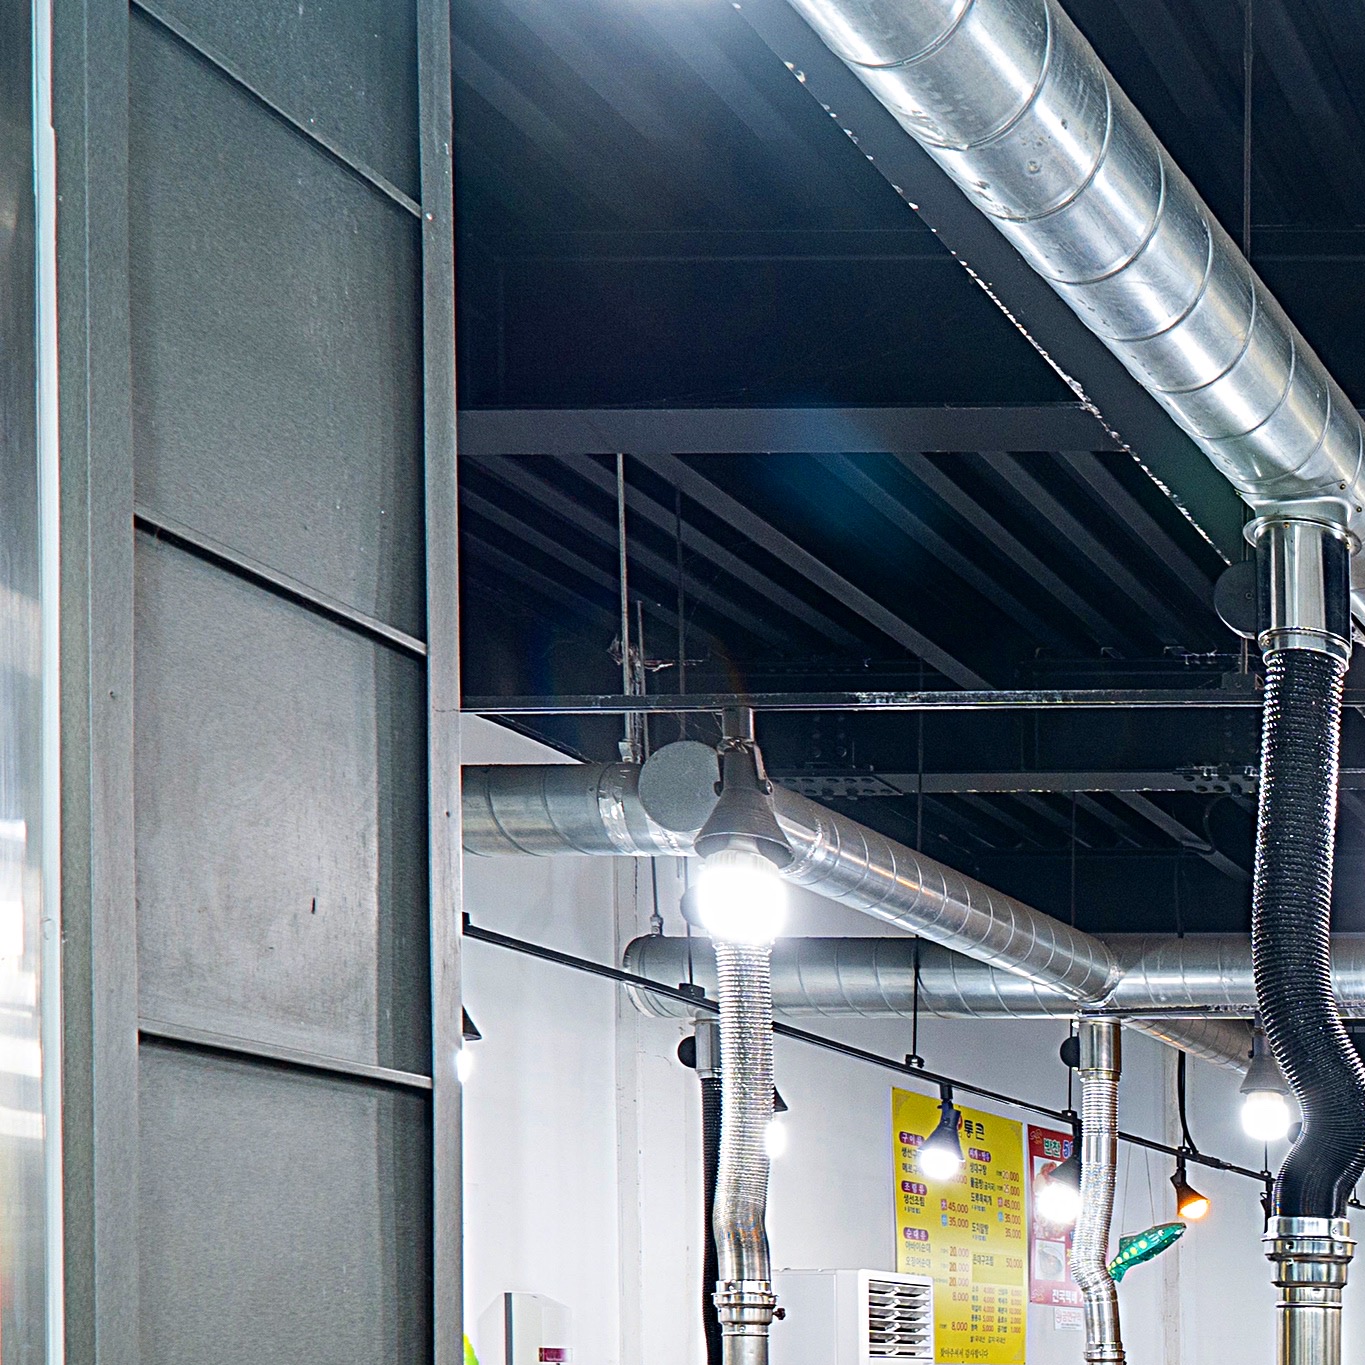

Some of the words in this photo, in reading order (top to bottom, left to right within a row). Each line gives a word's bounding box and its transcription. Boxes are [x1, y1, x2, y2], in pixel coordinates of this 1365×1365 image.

[948, 1202, 969, 1214] 45,000
[948, 1216, 969, 1228] 35,000
[1004, 1213, 1021, 1225] 35,000
[949, 1246, 970, 1258] 20,000
[949, 1262, 970, 1273] 20,000
[948, 1276, 970, 1287] 20,000
[952, 1291, 969, 1302] 8,000
[951, 1321, 969, 1332] 8,000
